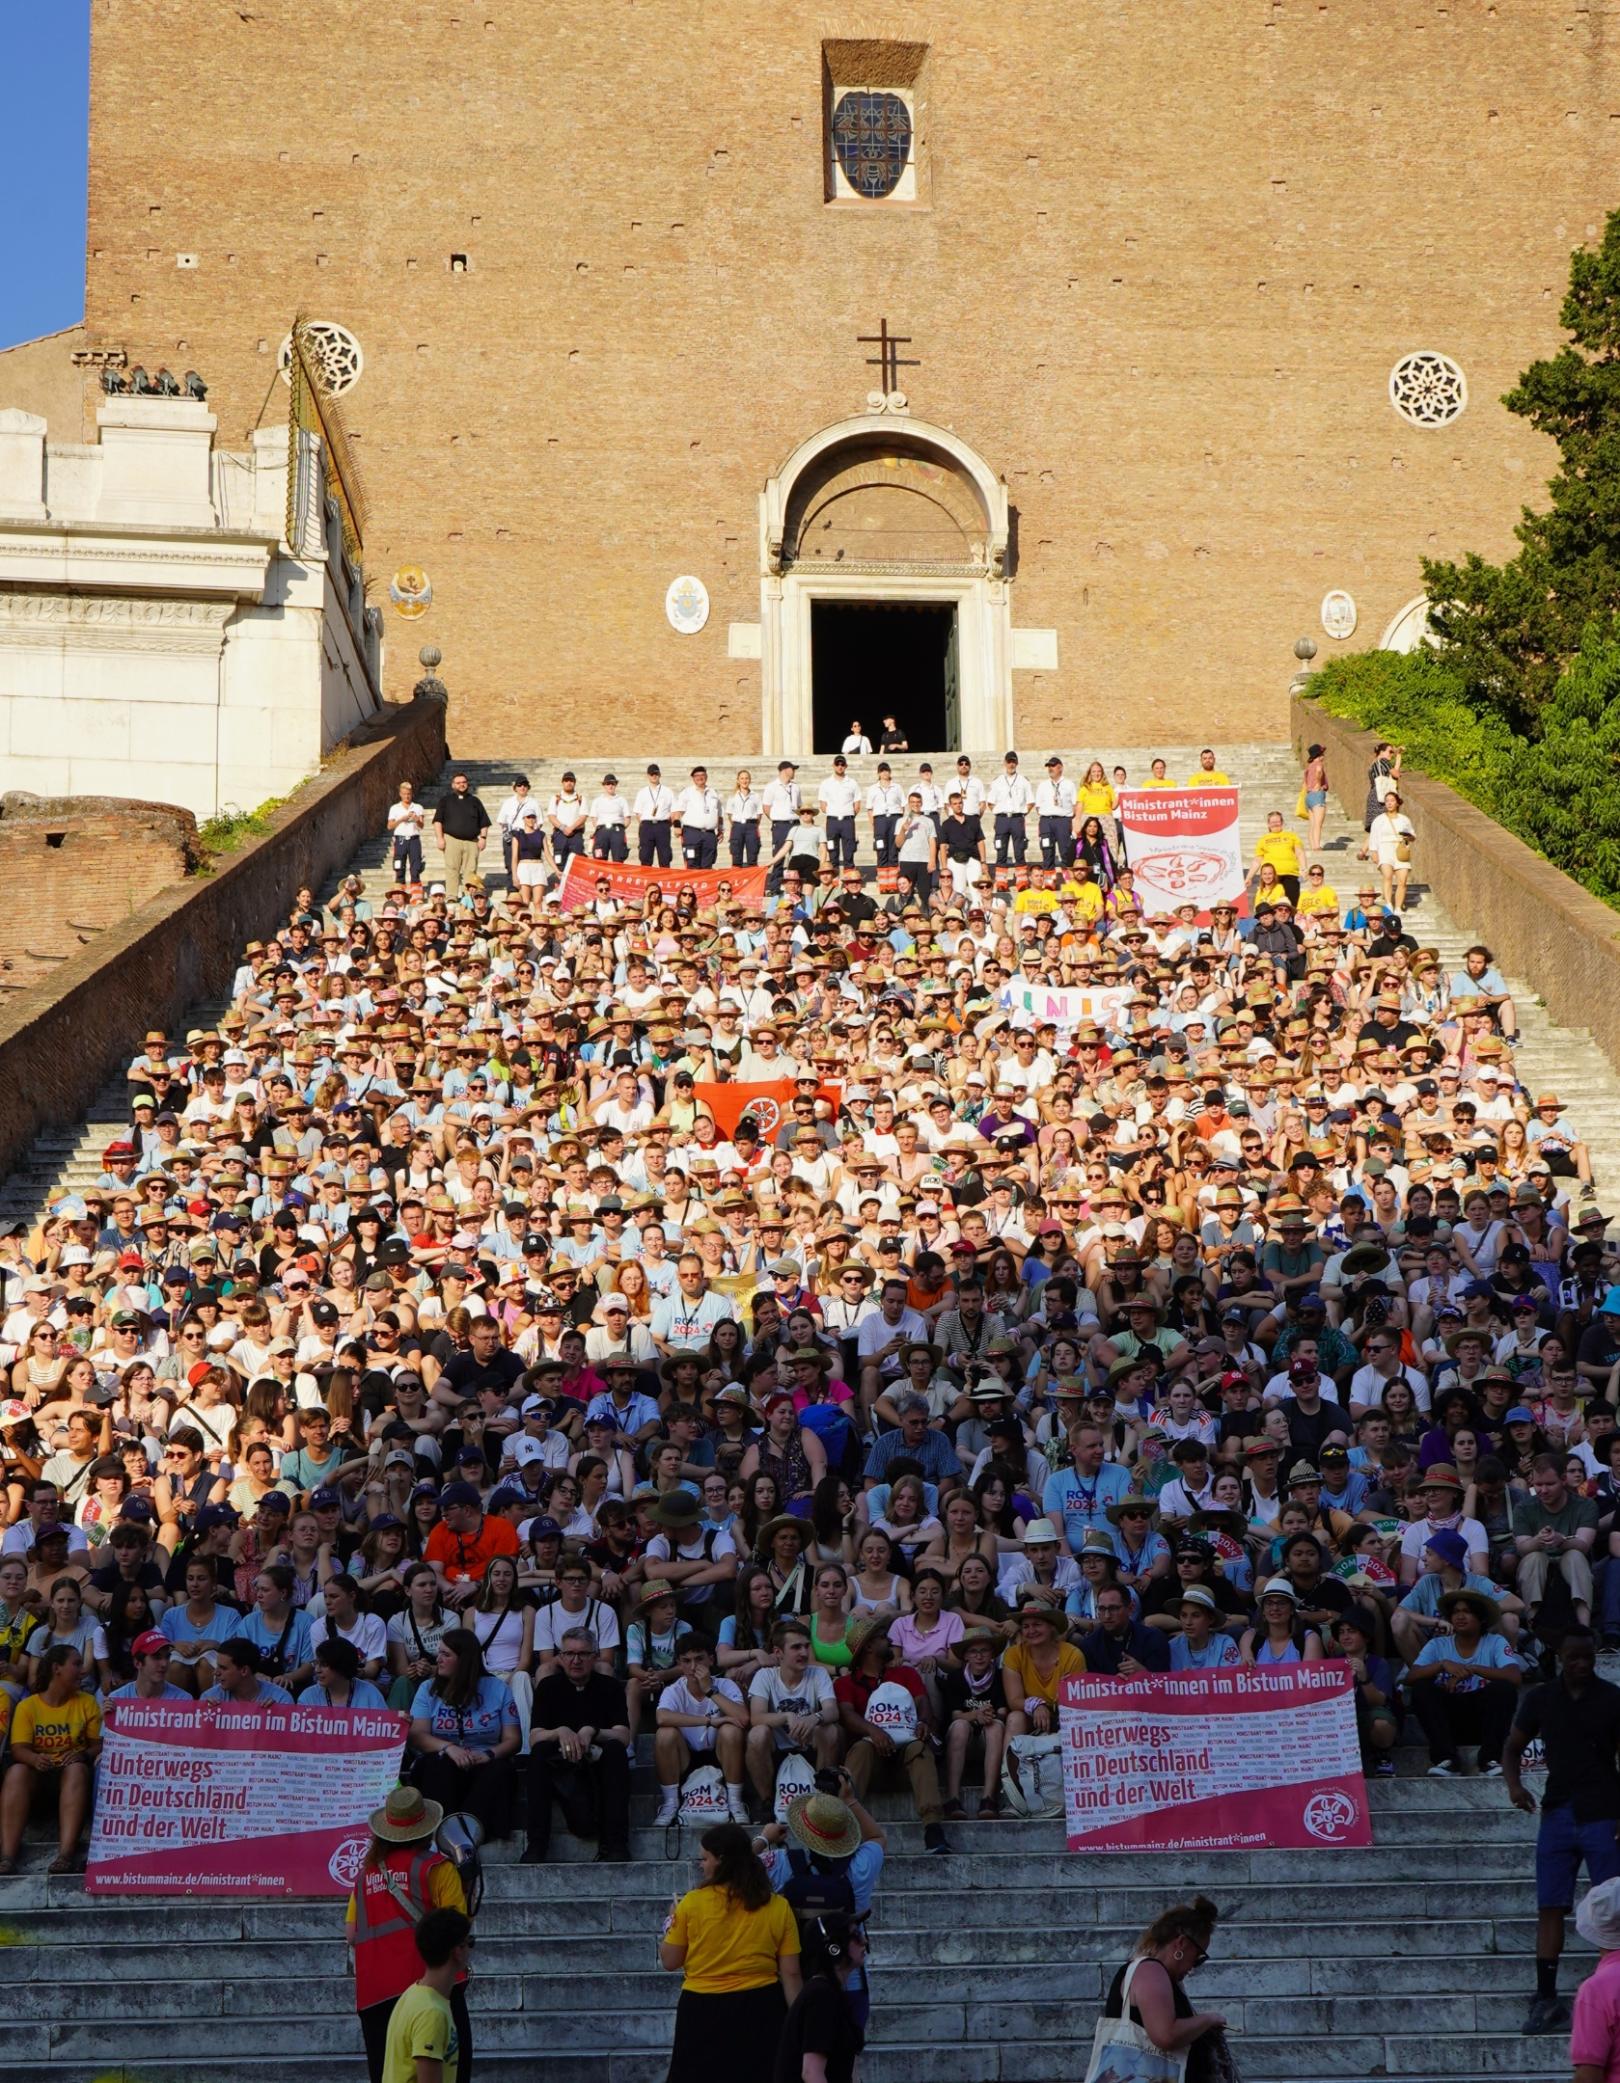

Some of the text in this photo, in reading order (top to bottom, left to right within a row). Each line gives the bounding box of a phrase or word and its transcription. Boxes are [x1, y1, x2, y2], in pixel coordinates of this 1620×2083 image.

[1123, 809, 1208, 822] Bistum Mainz
[673, 1326, 701, 1335] 2024
[674, 1317, 699, 1326] ROM
[1066, 1489, 1097, 1500] ROM
[1065, 1500, 1098, 1510] 2024
[1367, 1560, 1387, 1579] 2024
[1212, 1674, 1233, 1694] im
[1236, 1672, 1294, 1693] Bistum
[1296, 1666, 1345, 1689] Mainz
[35, 1724, 70, 1736] ROM
[265, 1710, 286, 1731] im
[290, 1712, 348, 1736] Bistum
[352, 1716, 401, 1739] Mainz
[35, 1736, 73, 1748] 2024
[1071, 1725, 1171, 1749] Unterwegs
[110, 1752, 213, 1783] Unterwegs
[1073, 1747, 1210, 1778] in Deutschland
[106, 1781, 246, 1809] in Deutschland
[779, 1783, 811, 1794] ROM
[1075, 1778, 1196, 1809] und der Welt
[102, 1813, 227, 1840] und der Welt
